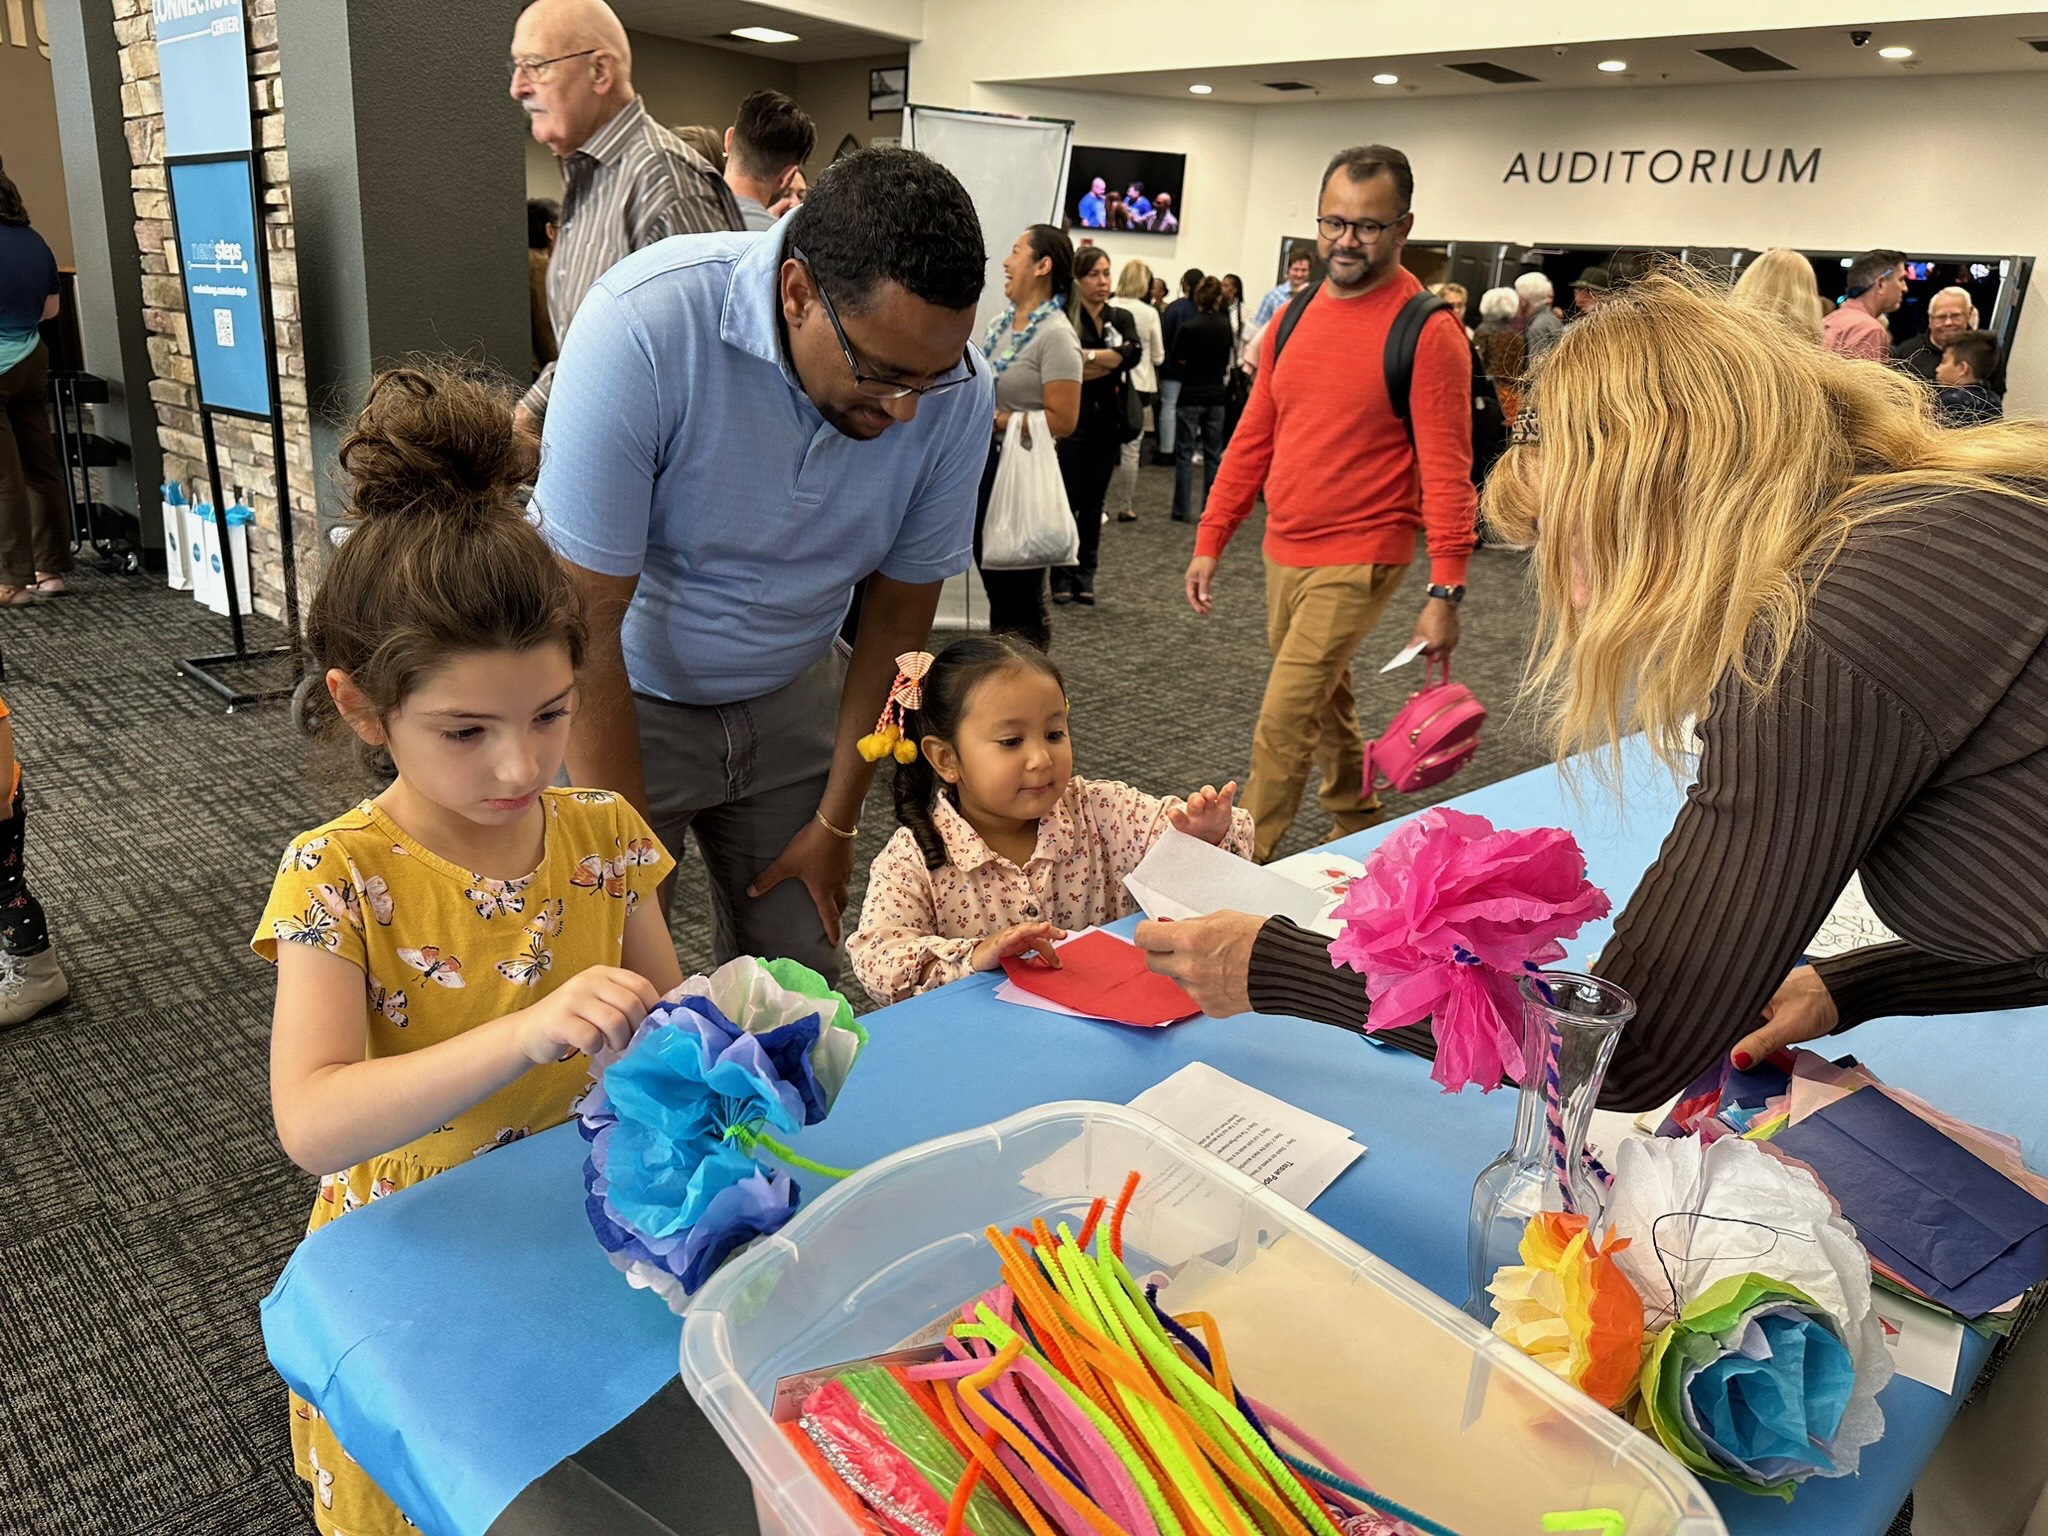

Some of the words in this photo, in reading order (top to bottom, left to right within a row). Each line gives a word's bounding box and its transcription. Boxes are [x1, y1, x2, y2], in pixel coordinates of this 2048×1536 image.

[153, 0, 239, 24] CONNEC
[211, 15, 240, 37] CENTER
[1503, 148, 1822, 184] AUDITORIUM
[1274, 1161, 1294, 1176] Tissue
[1263, 1174, 1278, 1186] Pap
